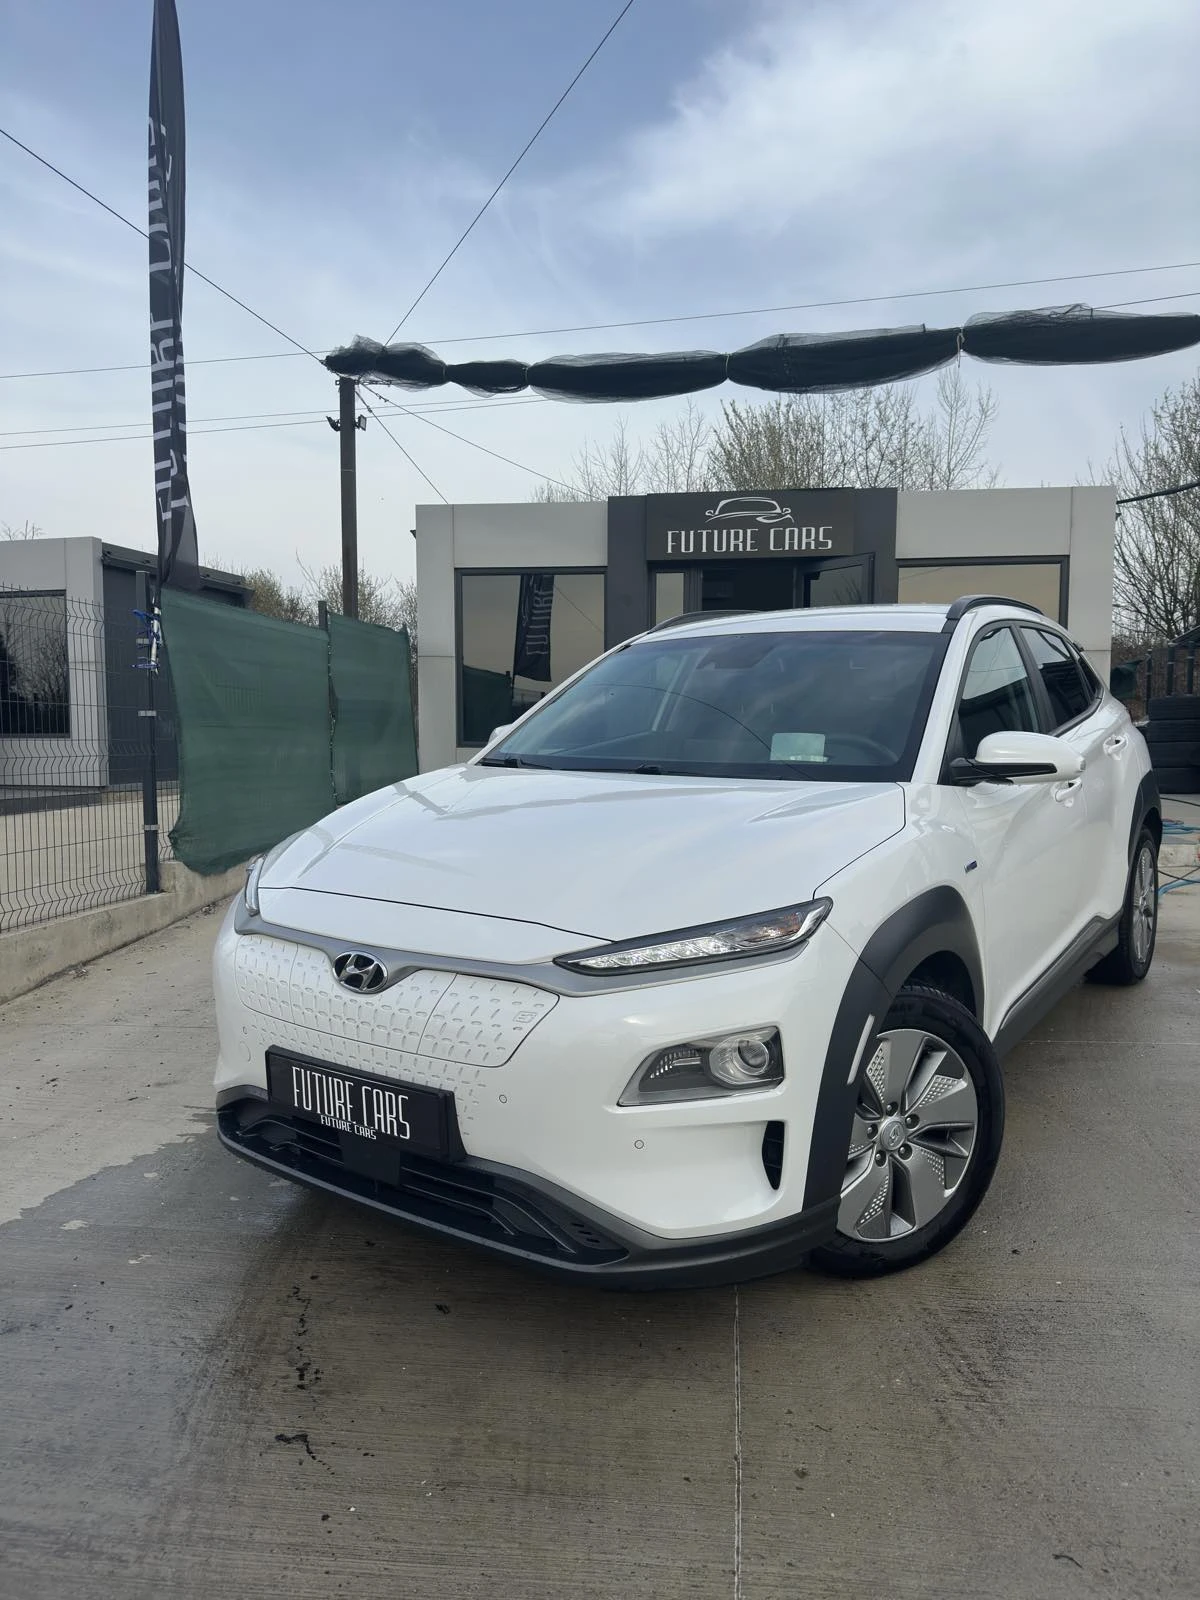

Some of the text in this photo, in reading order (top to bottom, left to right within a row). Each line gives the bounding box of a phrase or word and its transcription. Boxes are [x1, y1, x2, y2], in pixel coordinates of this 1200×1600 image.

[666, 526, 833, 554] FUTURE CARS
[292, 1066, 411, 1140] FUTURE CARS
[320, 1114, 377, 1140] FUTURE CARS
